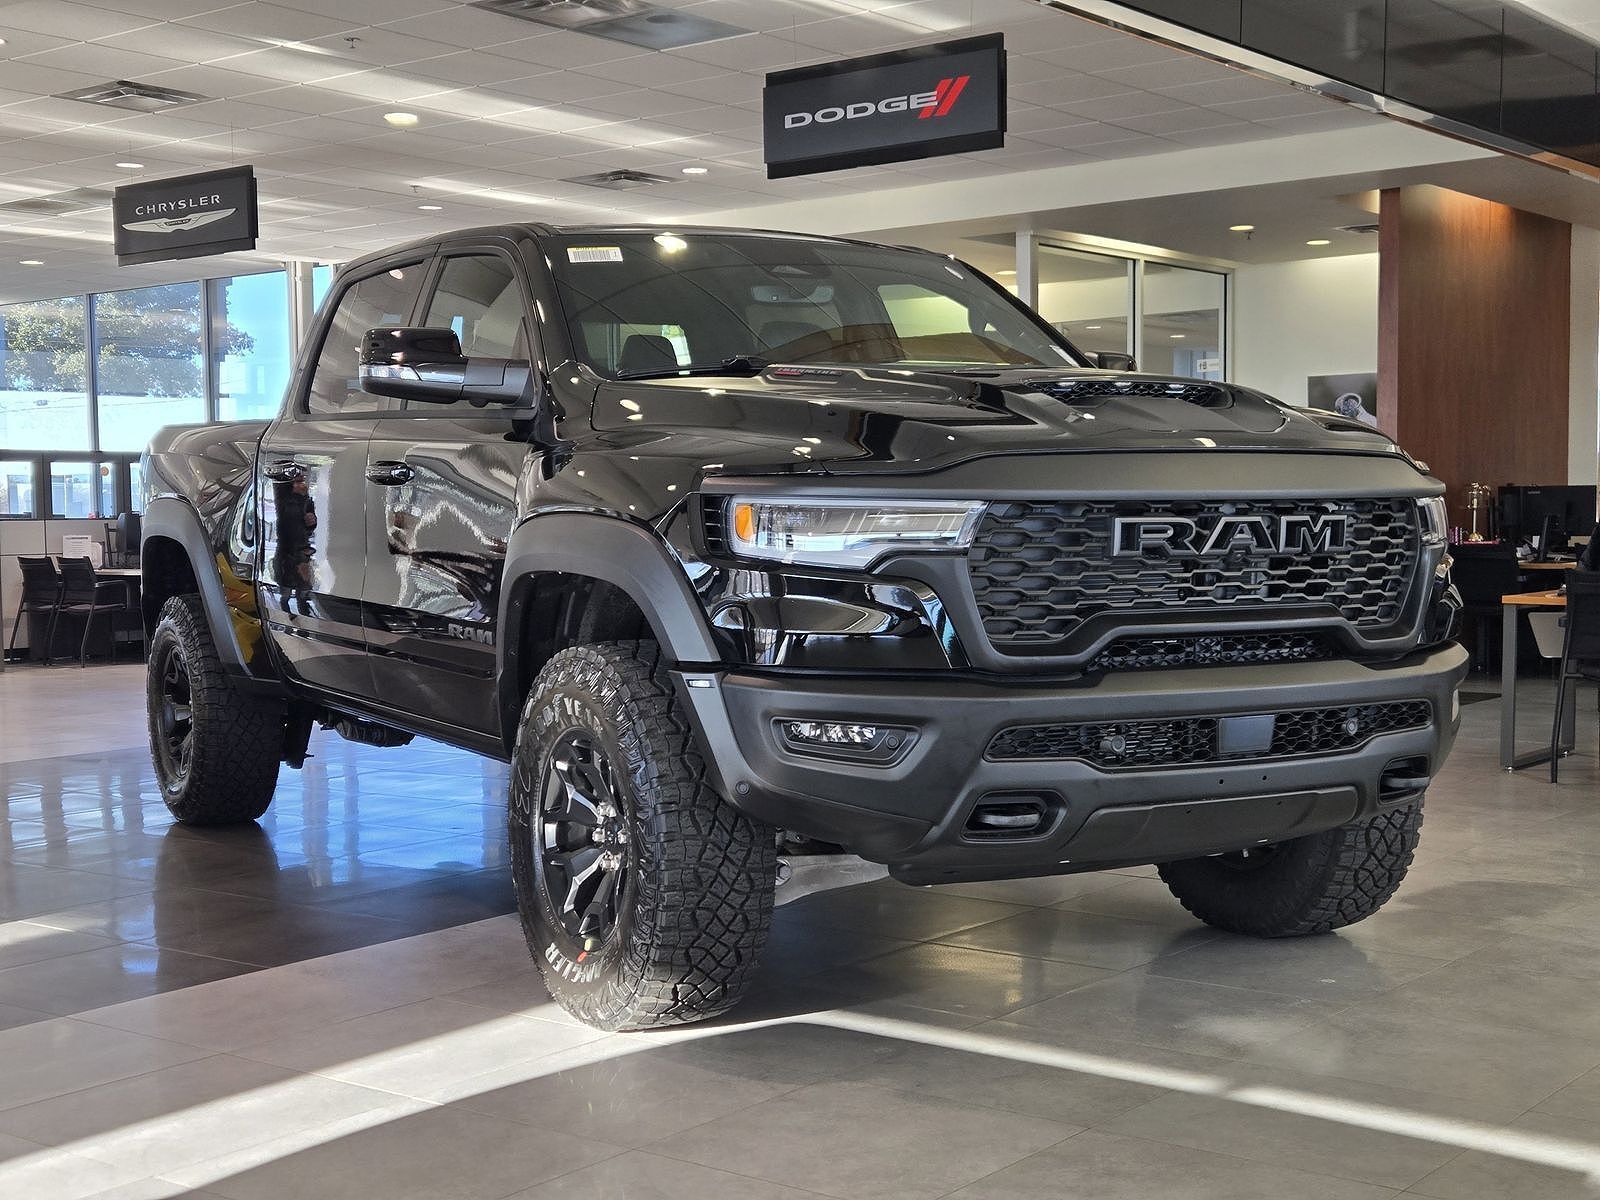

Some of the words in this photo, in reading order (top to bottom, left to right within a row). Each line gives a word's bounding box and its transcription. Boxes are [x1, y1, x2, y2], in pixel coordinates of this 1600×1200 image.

[784, 90, 938, 129] DODGE
[135, 194, 221, 216] CHRYSLER
[1113, 515, 1348, 557] RAM
[448, 623, 494, 646] RAM
